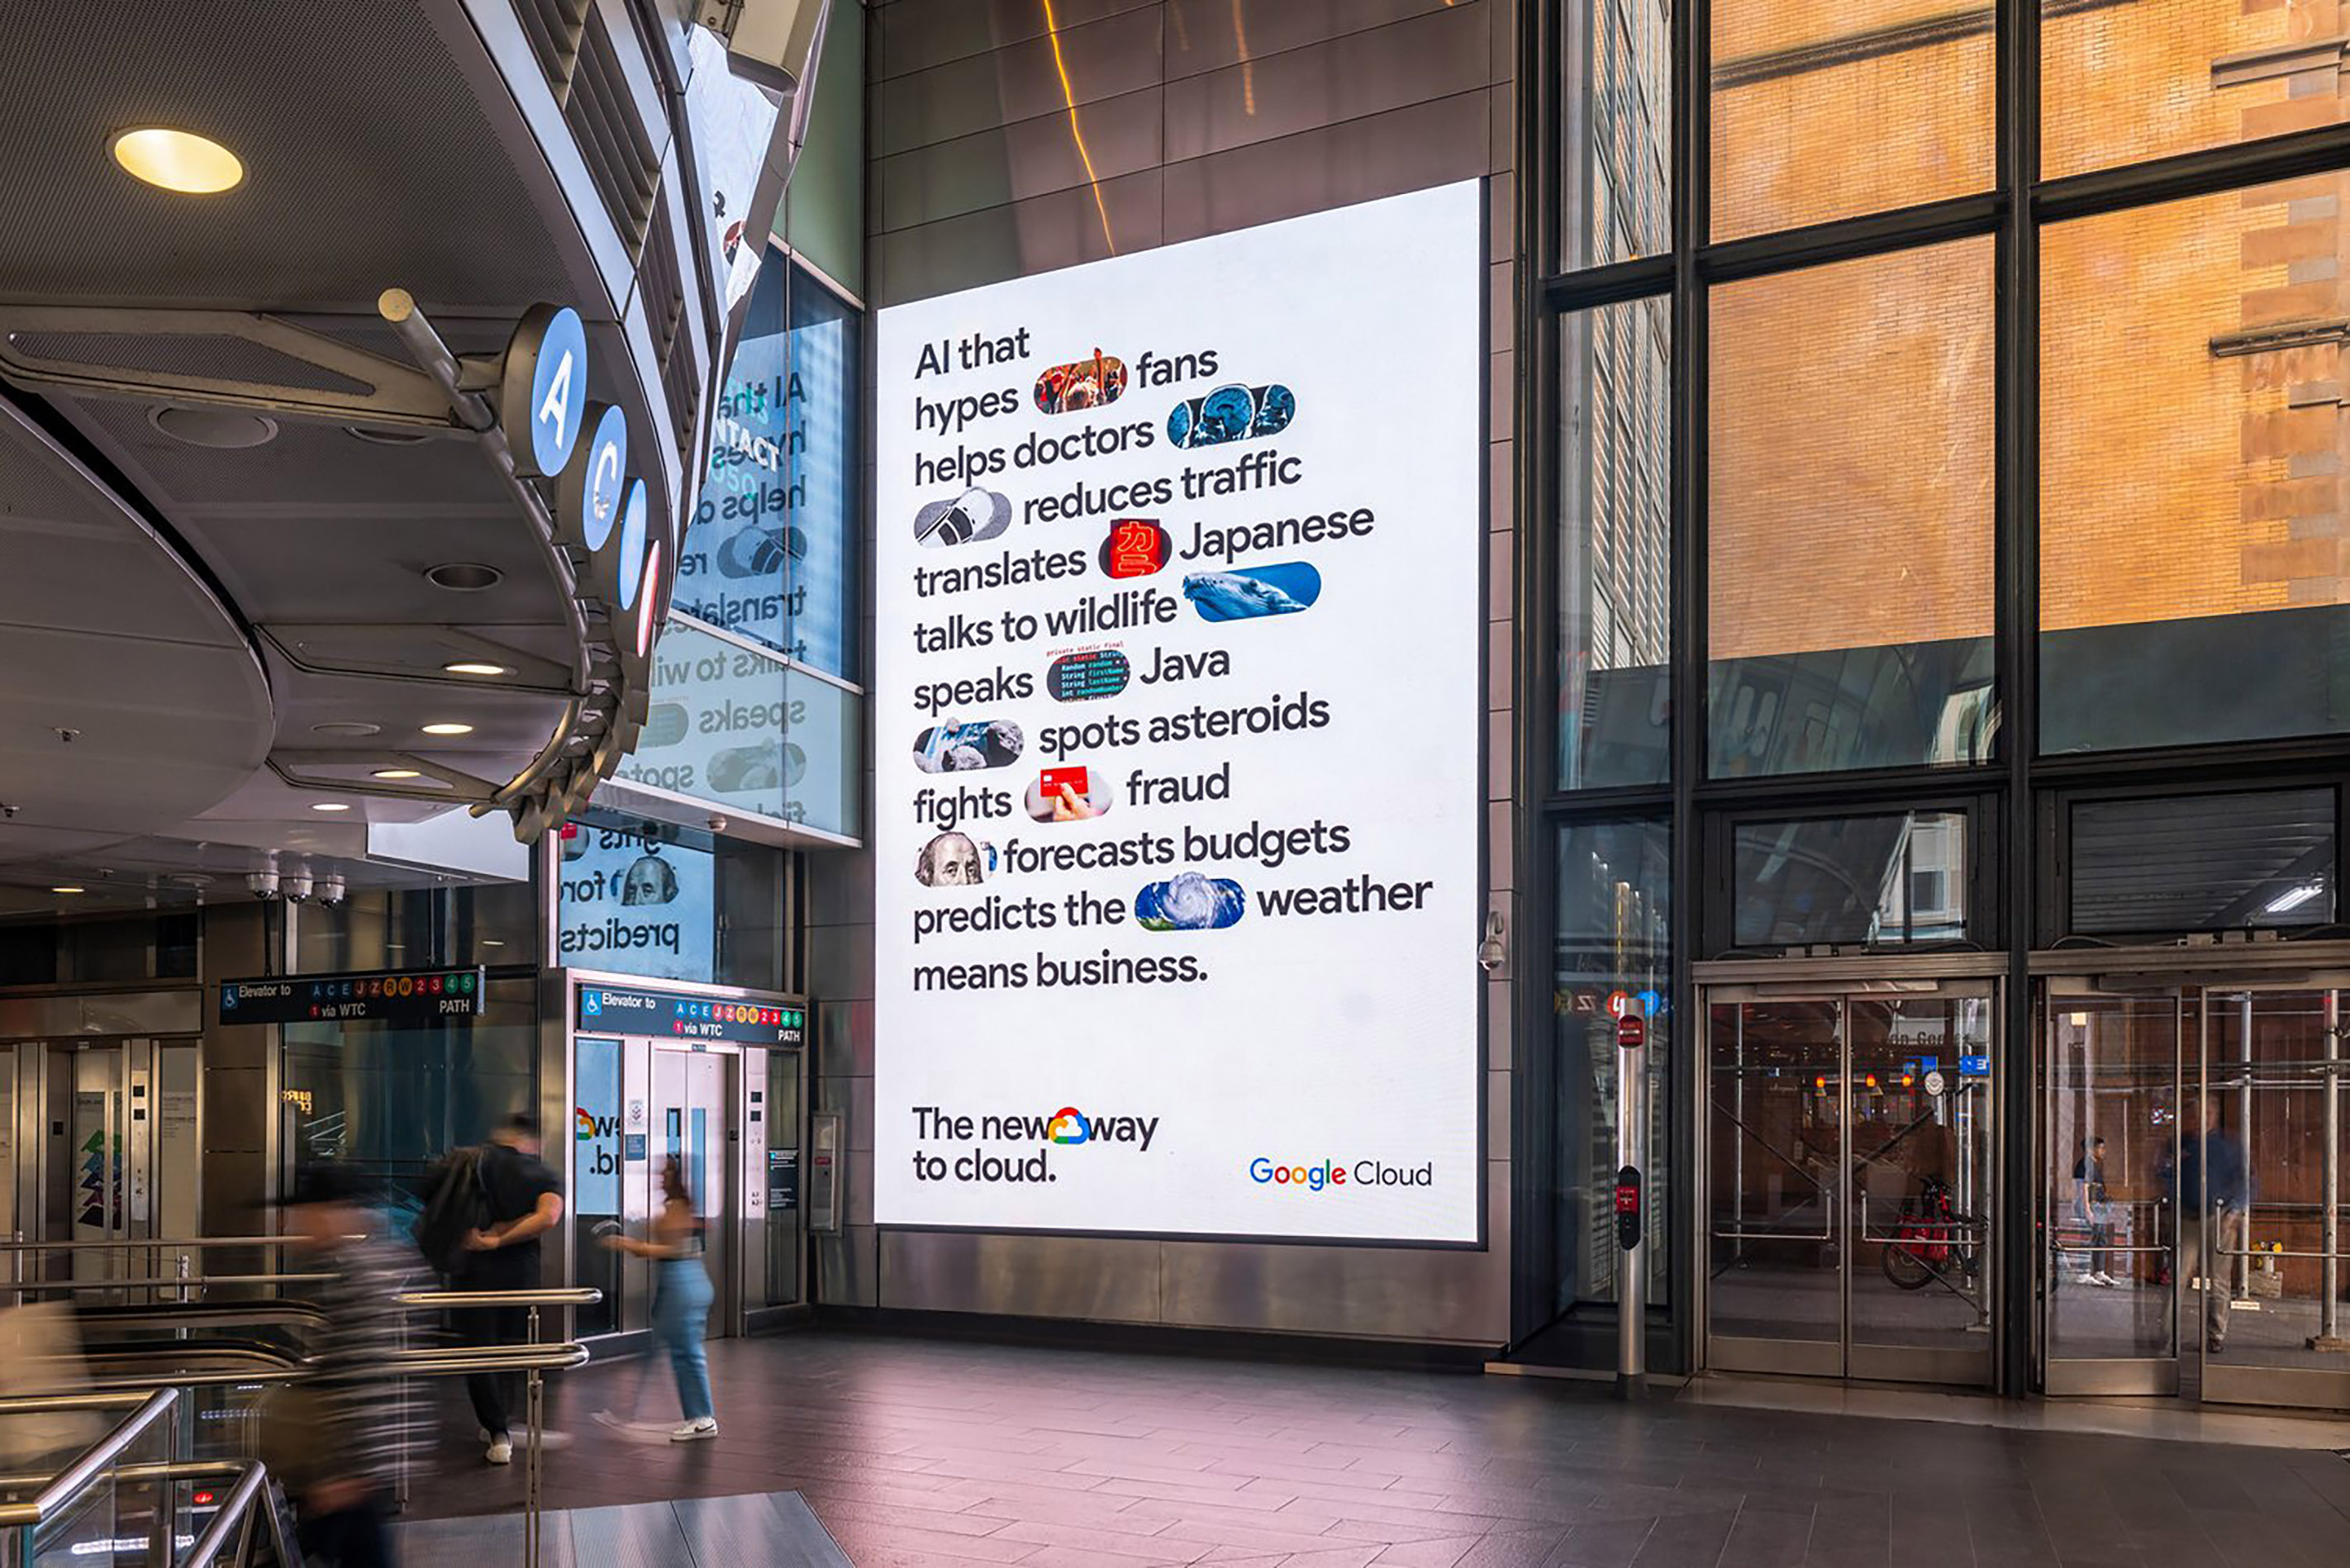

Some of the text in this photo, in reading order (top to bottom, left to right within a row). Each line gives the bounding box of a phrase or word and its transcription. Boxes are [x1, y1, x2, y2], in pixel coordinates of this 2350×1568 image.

[914, 326, 1030, 380] AI that
[540, 349, 573, 450] A
[914, 350, 1219, 436] hypes fans
[916, 421, 1155, 487] helps doctors
[1024, 449, 1302, 525] reduces traffic
[914, 508, 1374, 598] translates Japanese
[913, 587, 1177, 653] talks to wildlife
[914, 647, 1230, 718] speaks Java
[1039, 691, 1330, 762] spots asteroids
[913, 762, 1230, 831] fights fraud
[1003, 820, 1351, 873] forecasts budgets
[914, 873, 1434, 944] predicts the weather
[239, 985, 279, 998] Elevator
[281, 984, 292, 996] to
[914, 948, 1208, 991] means business.
[339, 1002, 366, 1017] WTC
[439, 999, 470, 1014] PATH
[602, 992, 643, 1008] Elevator
[699, 1022, 723, 1037] WTC
[778, 1029, 801, 1042] PATH
[911, 1106, 1159, 1152] The new way
[912, 1147, 1057, 1183] to cloud.
[1249, 1157, 1432, 1192] Google Cloud
